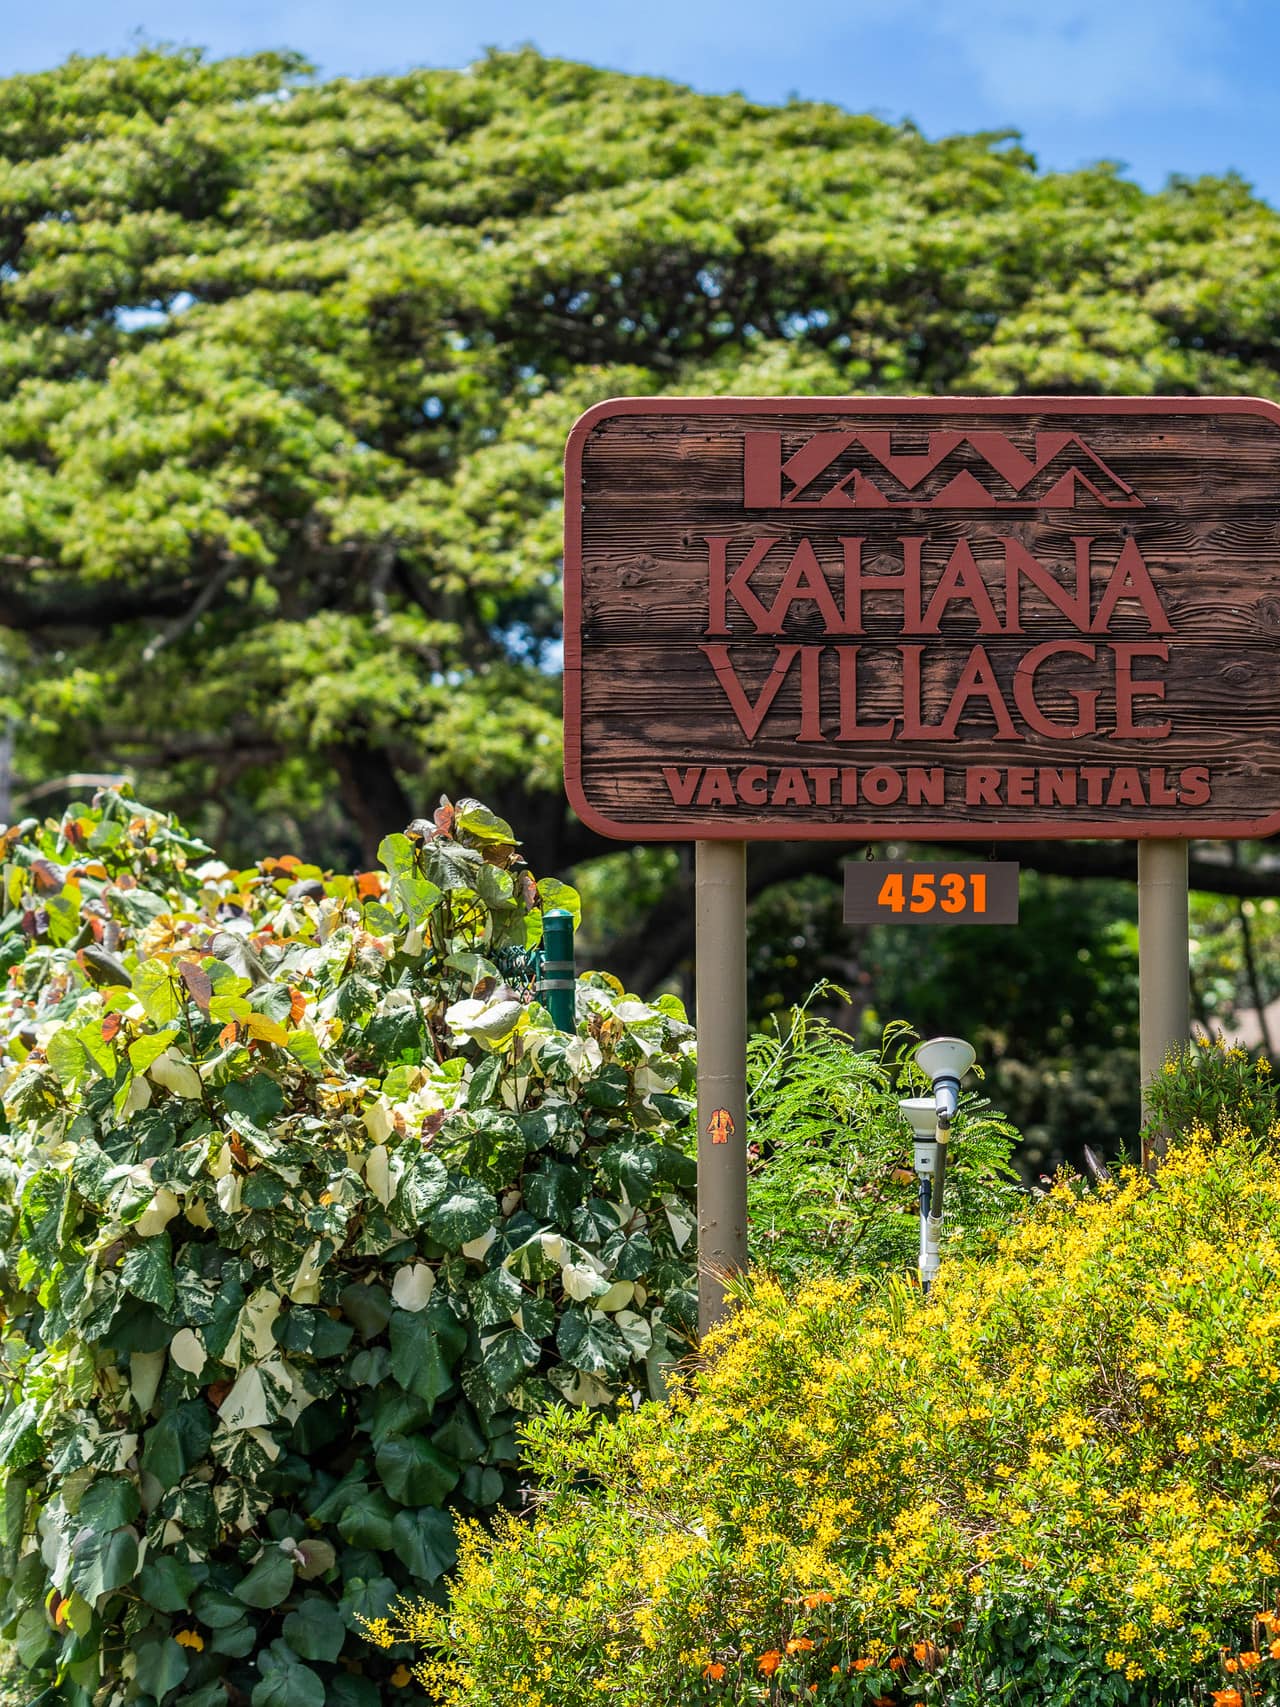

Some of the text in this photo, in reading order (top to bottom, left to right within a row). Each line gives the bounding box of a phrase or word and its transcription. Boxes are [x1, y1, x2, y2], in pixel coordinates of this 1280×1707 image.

[704, 537, 1177, 635] KAHANA
[700, 642, 1173, 742] VILLAGE
[663, 767, 1213, 806] VACATION RENTALS
[877, 874, 988, 914] 4531
